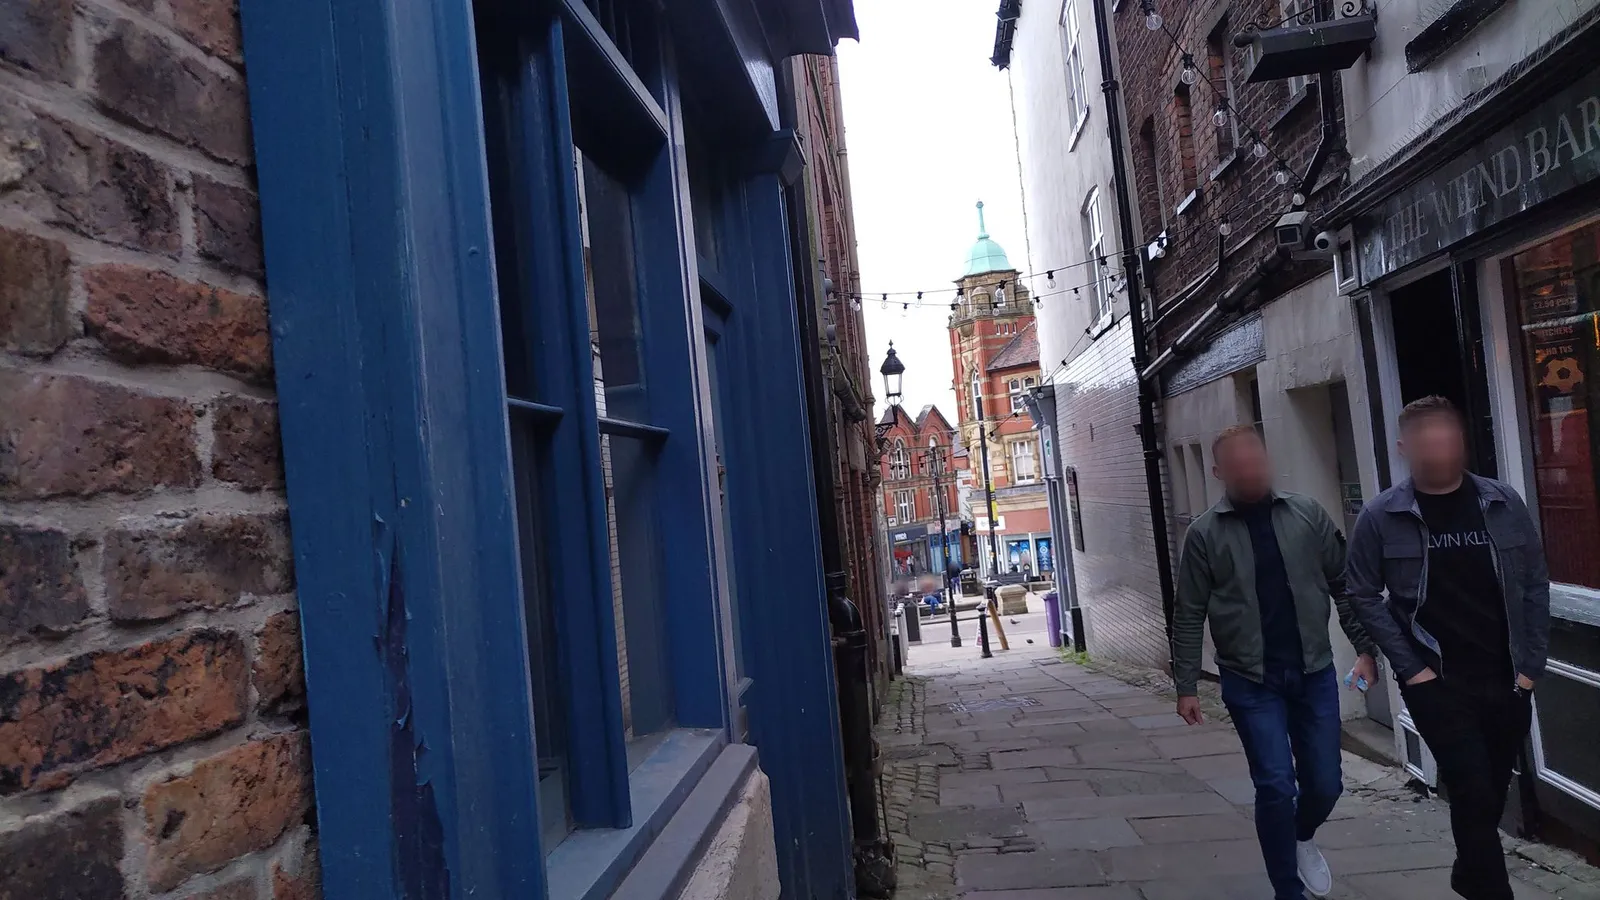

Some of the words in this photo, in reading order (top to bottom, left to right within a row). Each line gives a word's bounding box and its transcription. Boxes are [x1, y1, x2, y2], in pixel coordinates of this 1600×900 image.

[1386, 196, 1429, 251] THE
[1430, 145, 1522, 227] WIEND
[1526, 97, 1600, 182] BAR
[1428, 532, 1461, 548] LVIN
[1464, 531, 1489, 545] KLE
